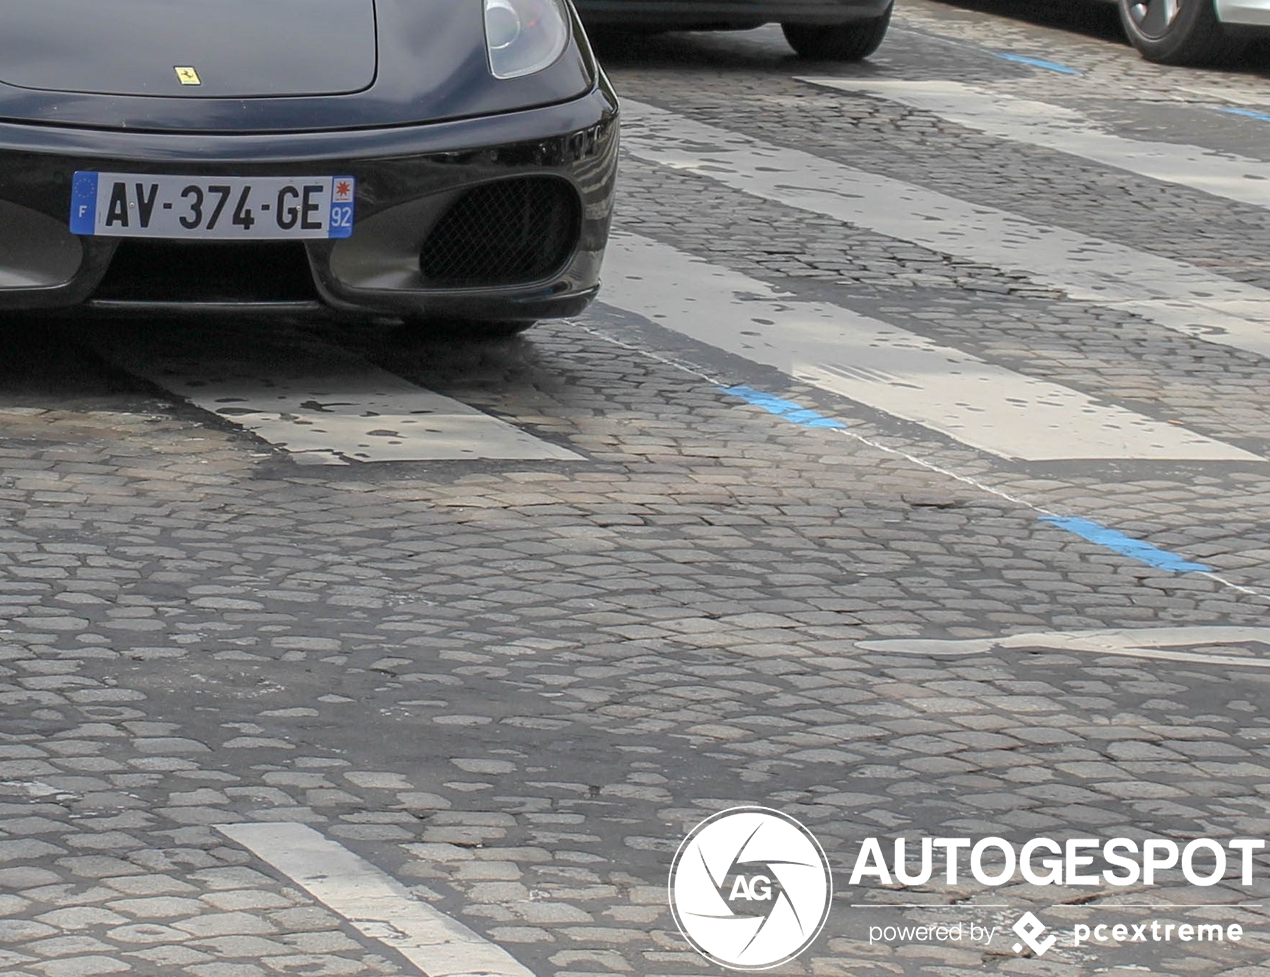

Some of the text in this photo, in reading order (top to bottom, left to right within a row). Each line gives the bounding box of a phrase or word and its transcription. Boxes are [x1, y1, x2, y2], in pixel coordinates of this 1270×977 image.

[78, 182, 352, 231] F AV-374-GE 92
